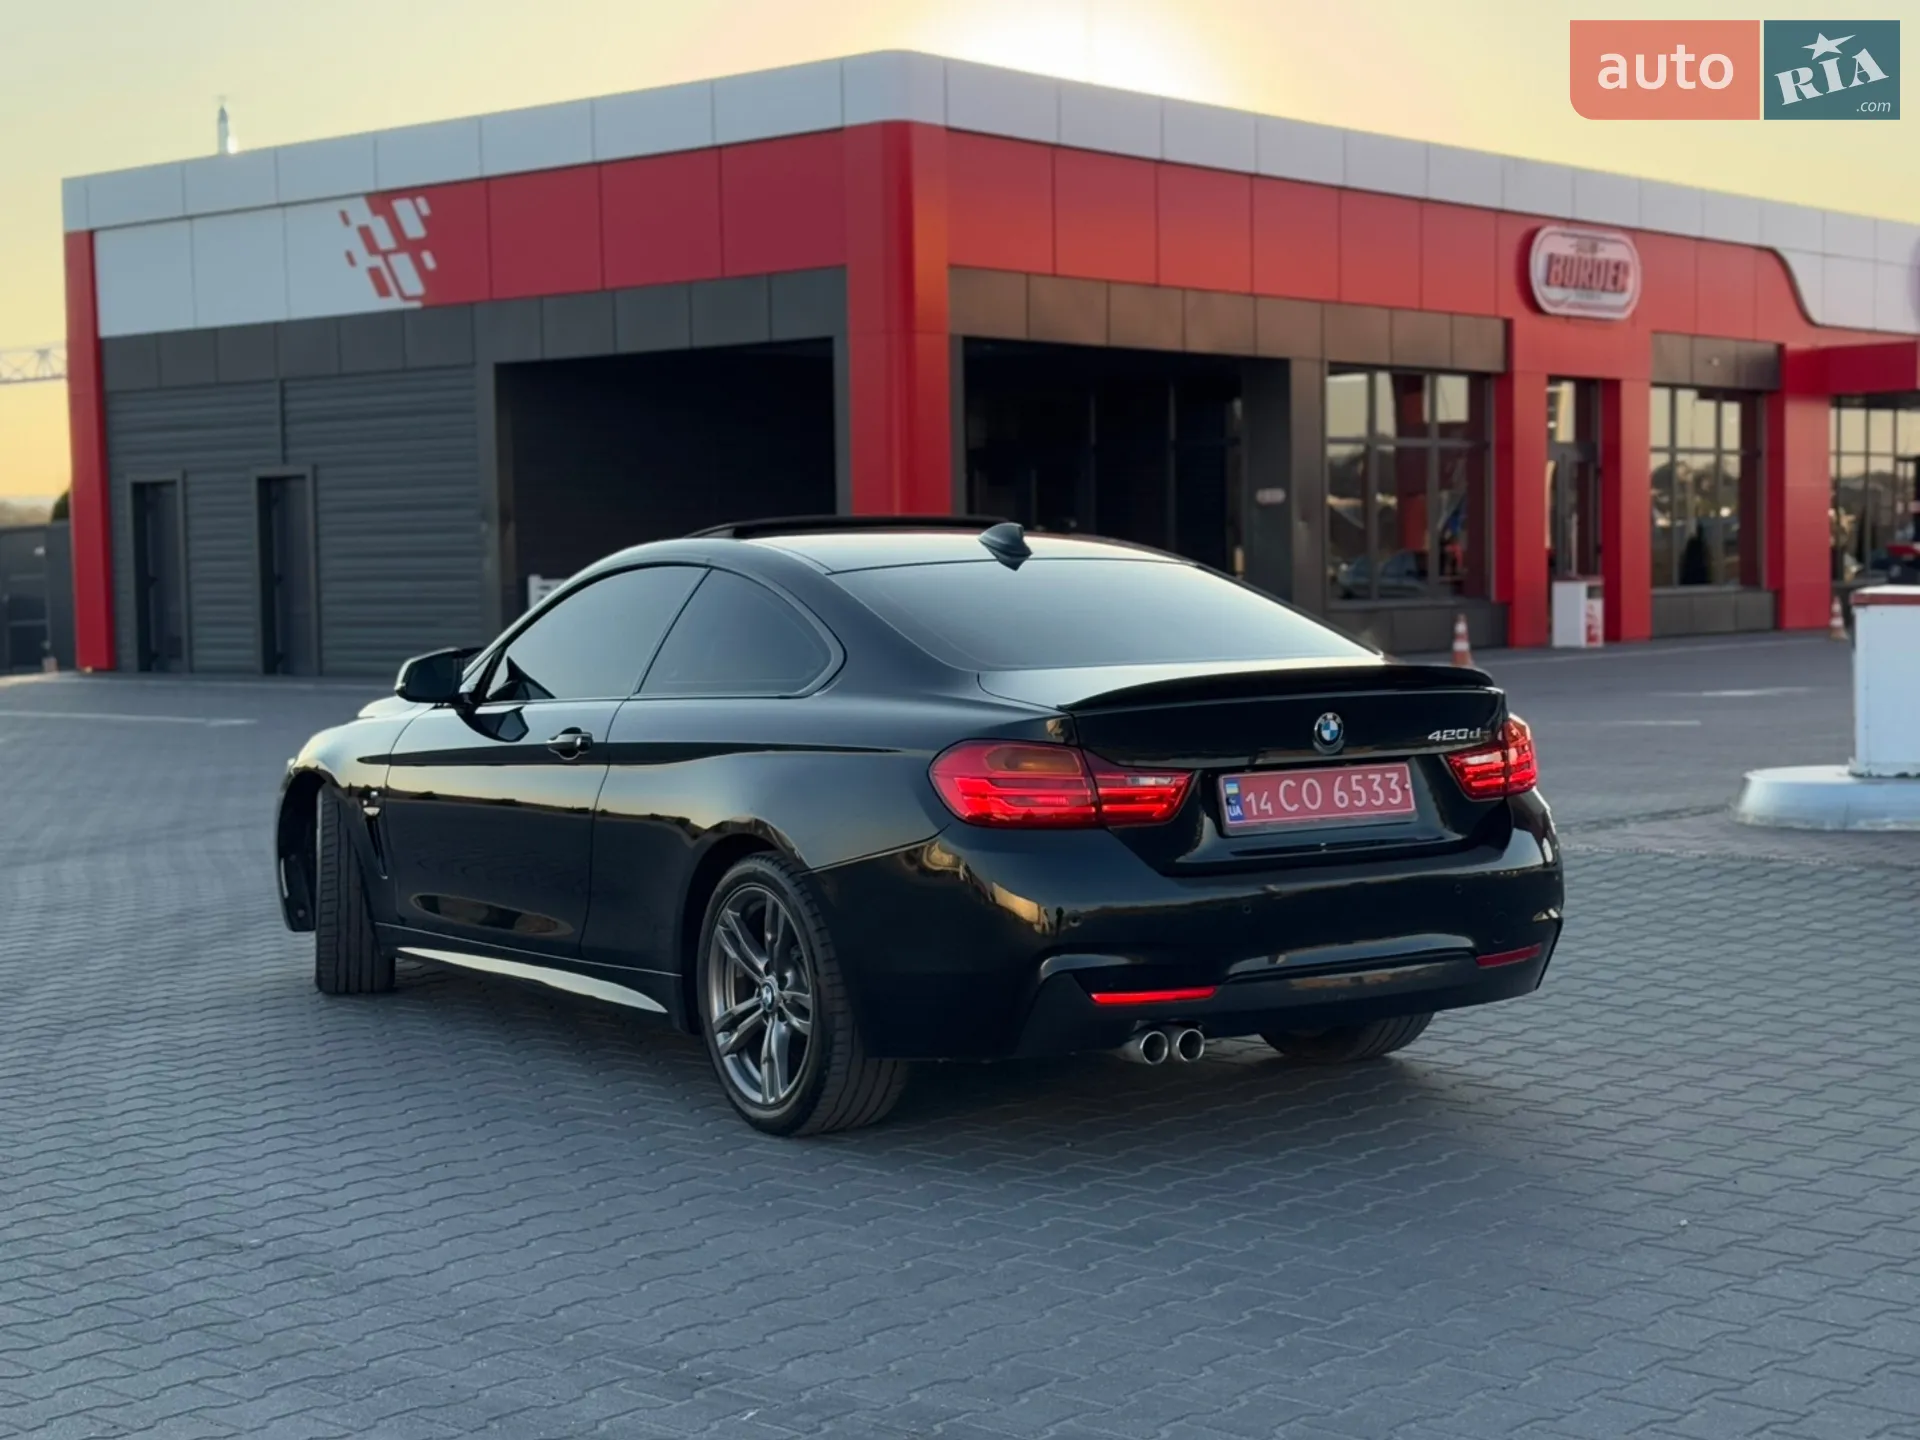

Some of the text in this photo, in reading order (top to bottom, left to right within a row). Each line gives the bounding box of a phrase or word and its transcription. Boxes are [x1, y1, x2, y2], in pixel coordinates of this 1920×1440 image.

[1427, 727, 1481, 741] 420d
[1245, 772, 1403, 816] 14 CO 6533
[1228, 804, 1243, 817] UA
